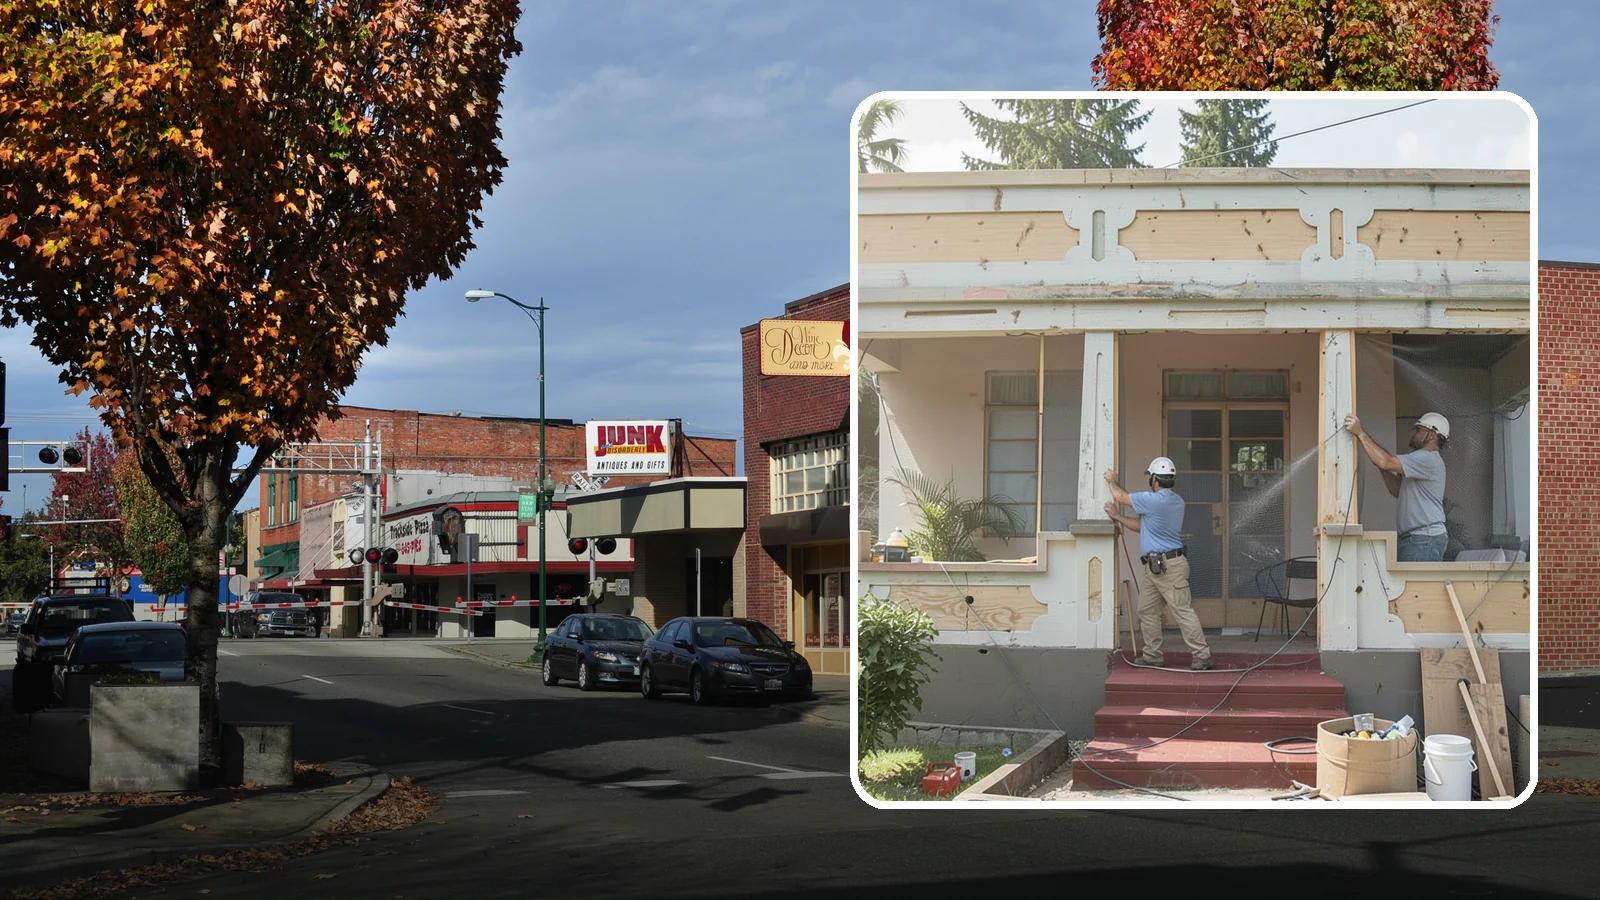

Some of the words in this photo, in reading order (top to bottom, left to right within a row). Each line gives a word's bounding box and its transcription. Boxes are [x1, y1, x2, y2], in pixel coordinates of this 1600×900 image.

[596, 425, 665, 457] JUNK
[607, 446, 646, 454] DISORDERLY
[597, 461, 628, 470] ANTIQUES
[631, 461, 643, 470] AND
[647, 460, 665, 470] GIFTS
[590, 476, 608, 491] SING
[415, 519, 429, 535] Pizza
